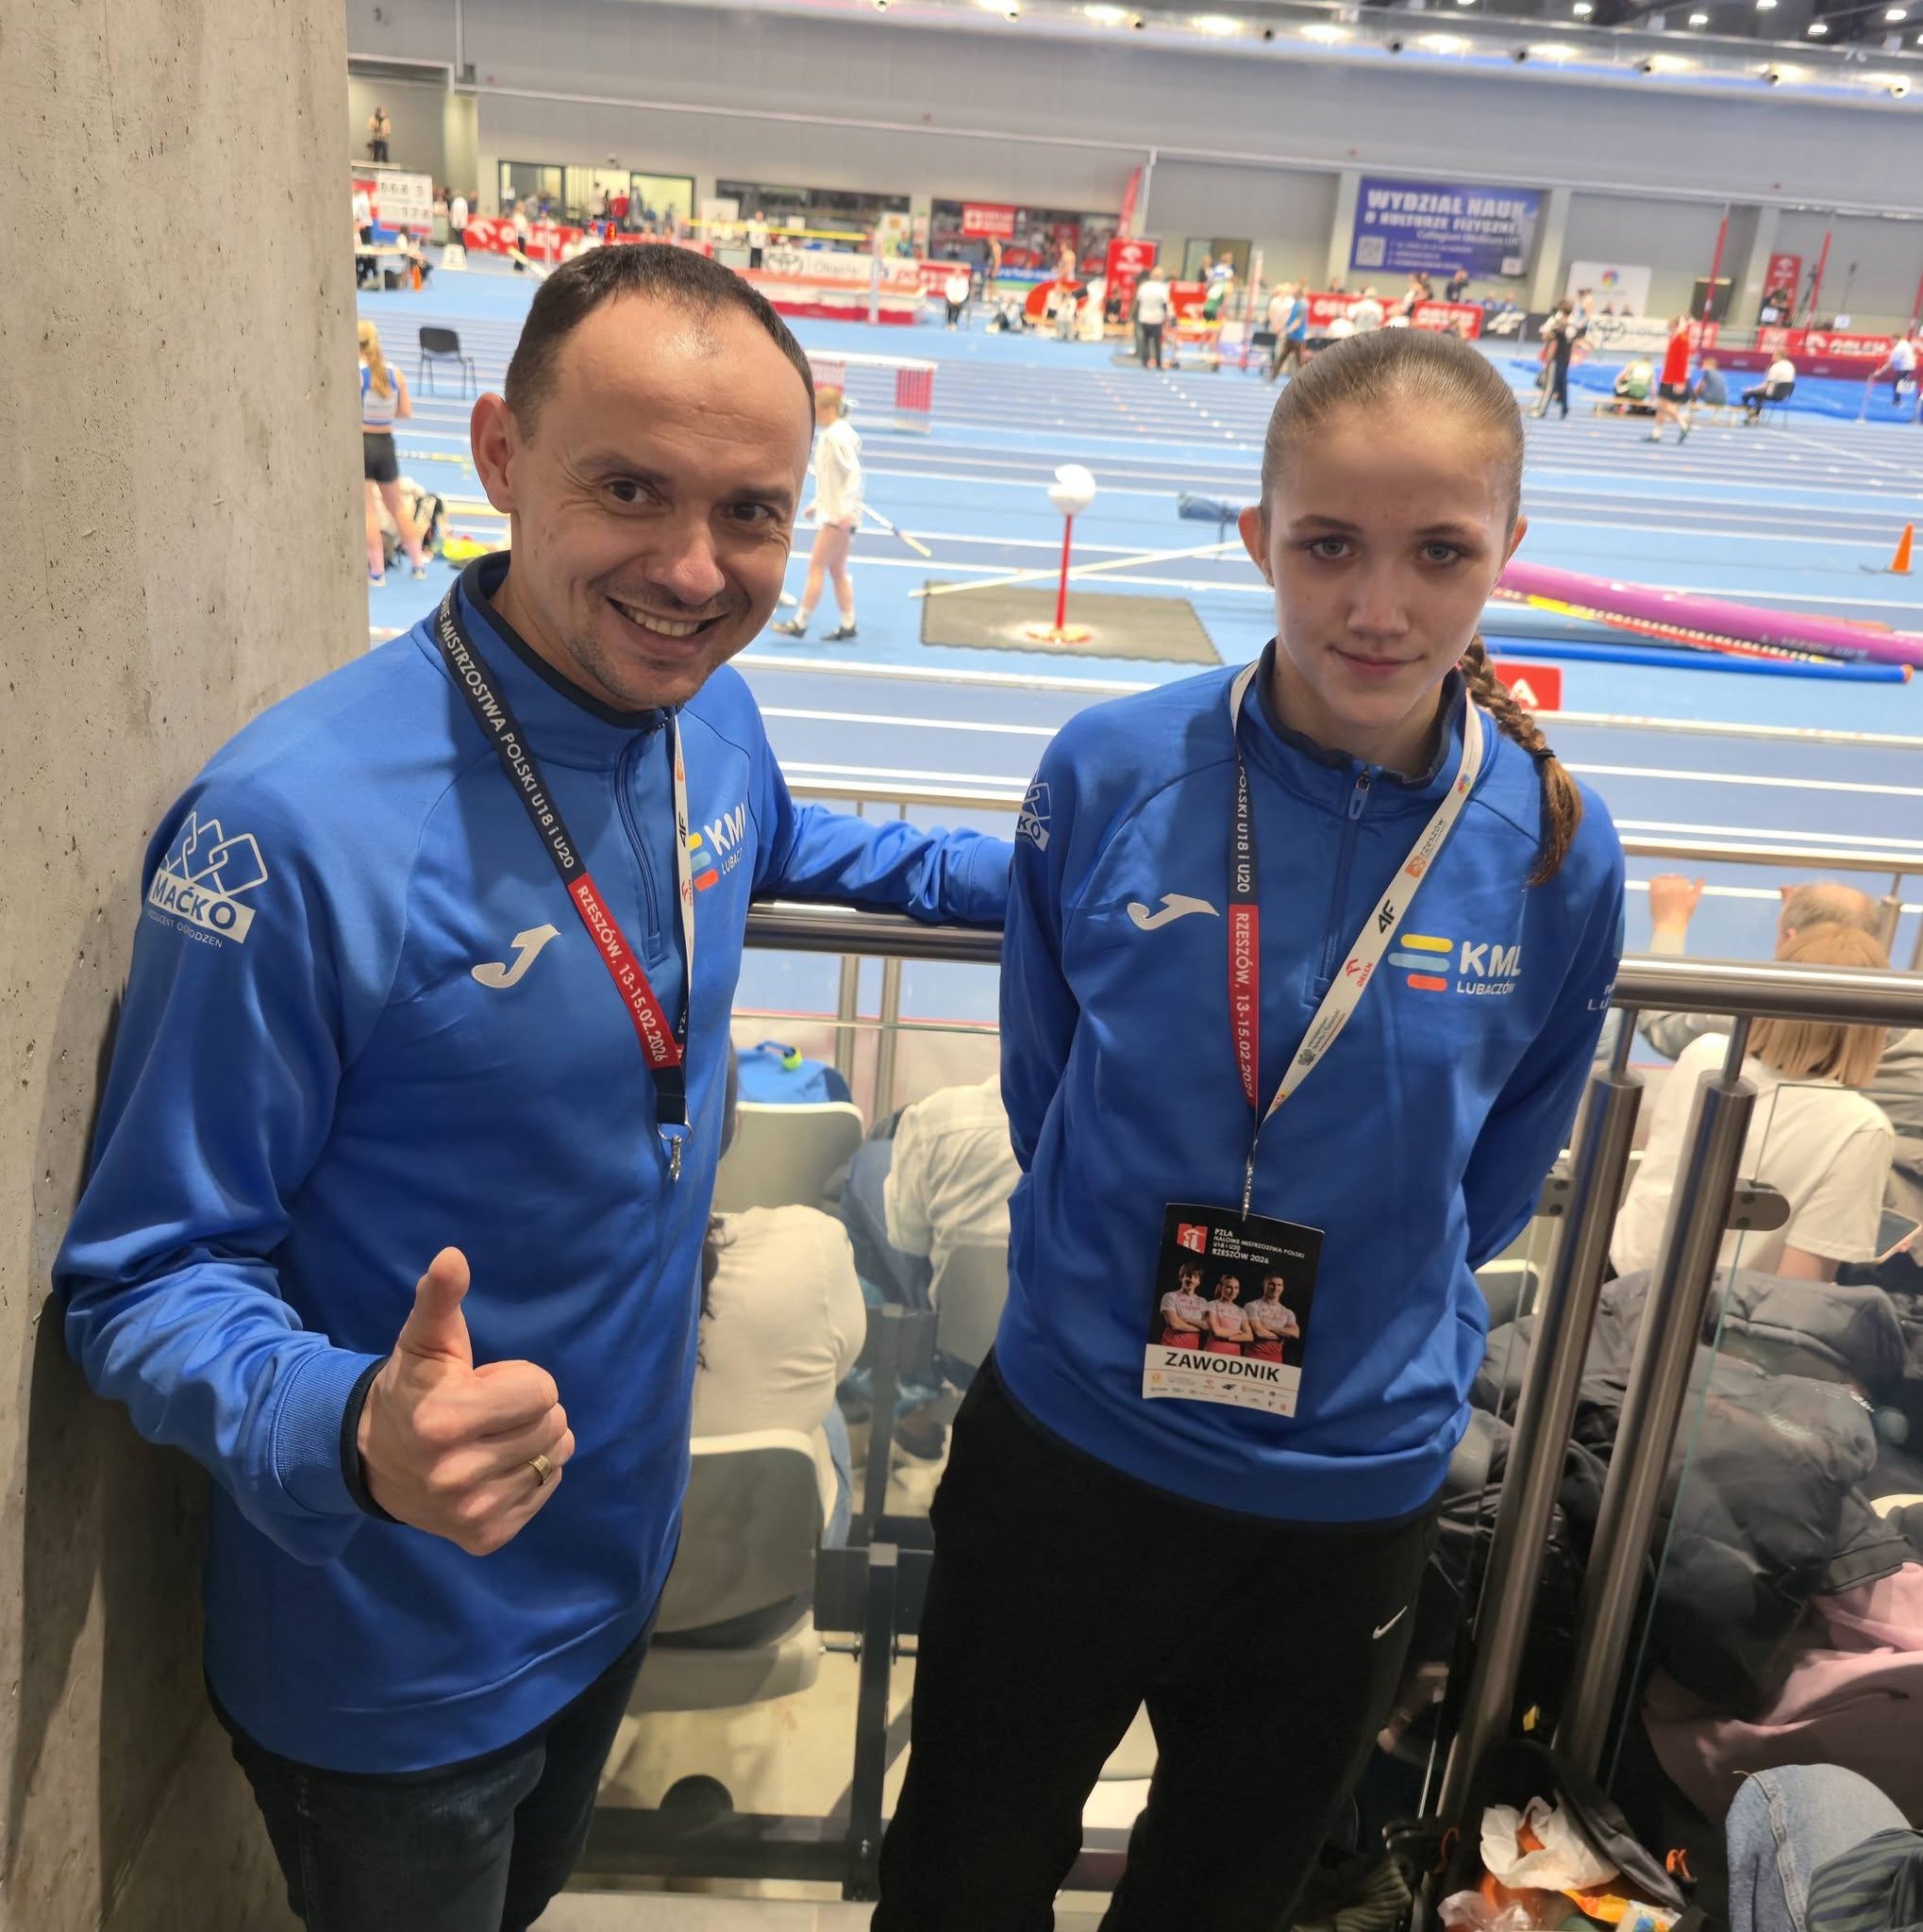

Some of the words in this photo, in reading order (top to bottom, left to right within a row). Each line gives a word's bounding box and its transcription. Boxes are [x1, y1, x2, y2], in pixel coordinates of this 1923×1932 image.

[499, 225, 560, 249] OLEN
[441, 620, 506, 732] MISTRZOSTWA
[501, 733, 536, 791] POLSKI
[532, 793, 554, 826] U18
[554, 836, 575, 869] U20
[577, 885, 622, 964] RZESZÓW,
[619, 964, 668, 1062] 13-15.02.2026
[1237, 823, 1249, 851] U18
[1237, 864, 1250, 892] U20
[1235, 912, 1253, 988] RZESZÓW,
[1459, 941, 1522, 977] KML
[1457, 980, 1516, 995] LUBACZÓW
[1212, 1247, 1248, 1260] RZESZÓW
[1250, 1254, 1269, 1265] 2026
[1164, 1351, 1281, 1383] ZAWODNIK
